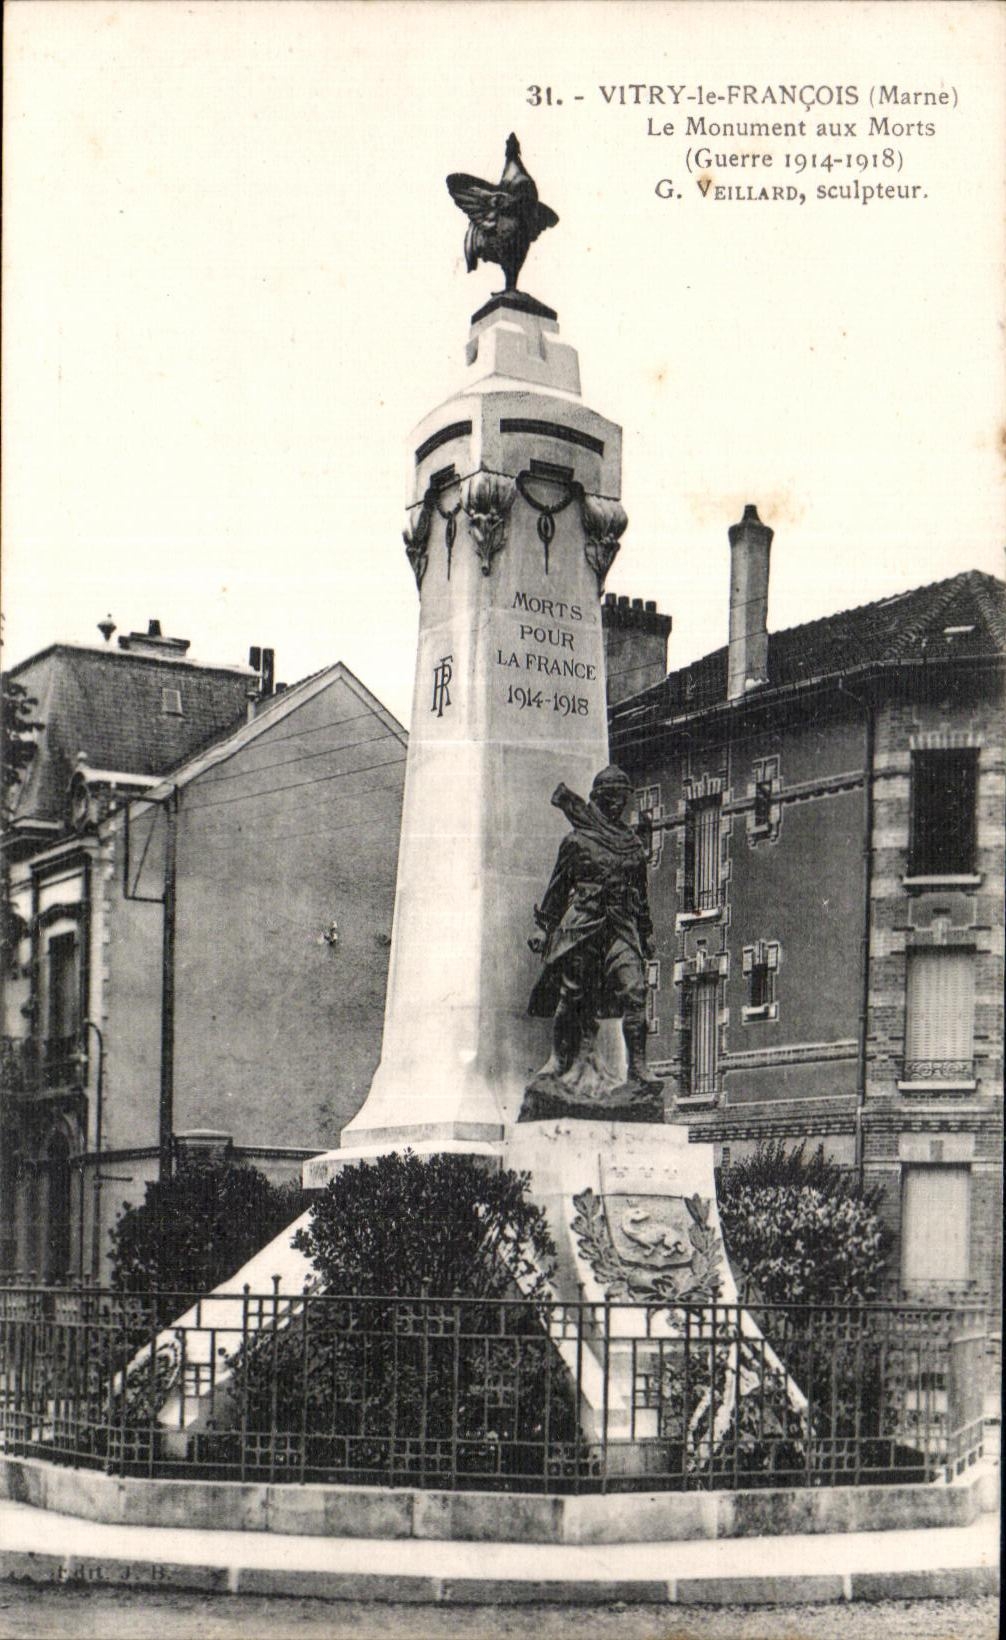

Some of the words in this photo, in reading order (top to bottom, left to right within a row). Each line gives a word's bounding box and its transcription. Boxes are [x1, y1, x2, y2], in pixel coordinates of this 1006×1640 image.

[512, 591, 583, 621] MORTS
[520, 624, 574, 652] POUR
[497, 649, 520, 669] LA
[525, 653, 597, 681] FRANCE
[507, 684, 589, 717] 1914-1918
